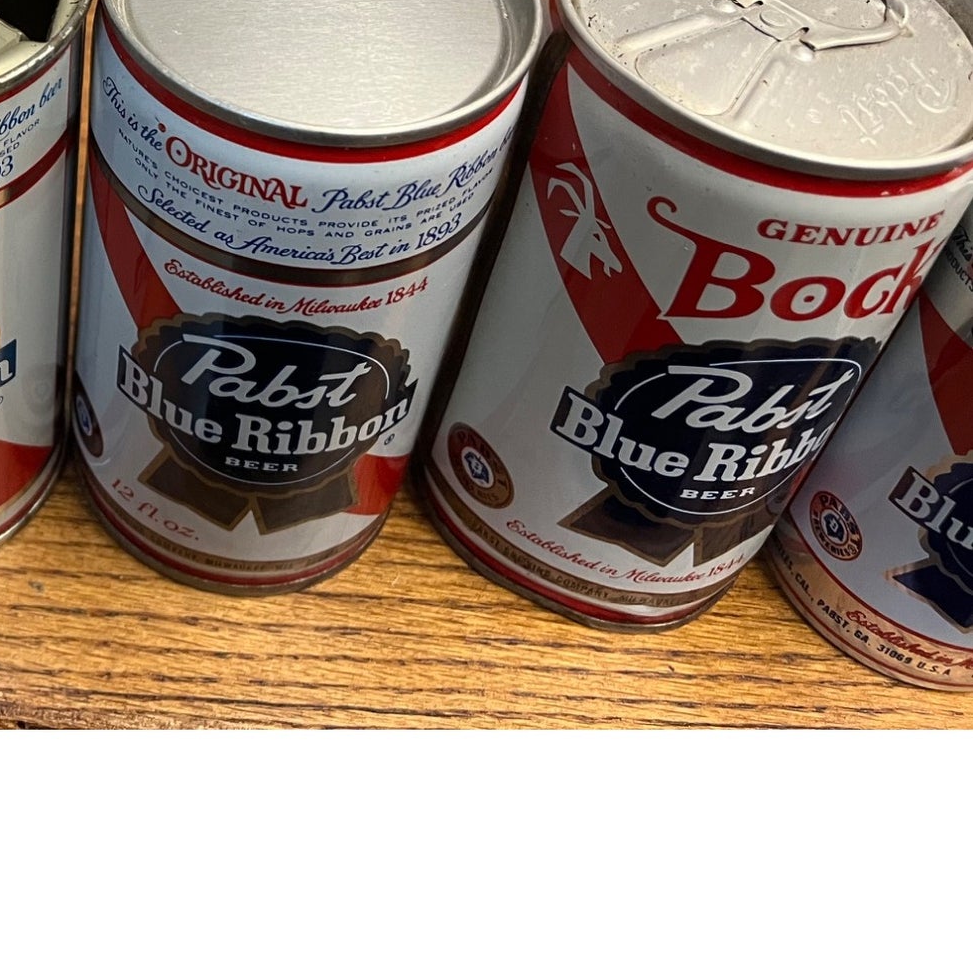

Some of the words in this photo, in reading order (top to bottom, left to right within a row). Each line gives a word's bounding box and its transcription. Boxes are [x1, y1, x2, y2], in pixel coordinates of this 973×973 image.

[38, 77, 63, 110] beer
[3, 118, 41, 148] FLAVOR
[102, 76, 127, 120] This
[127, 114, 139, 131] is
[140, 123, 163, 151] the
[166, 136, 309, 210] ORIGINAL
[311, 188, 385, 213] Pabst
[382, 178, 441, 211] Blue
[436, 148, 499, 198] Ribbon
[118, 127, 158, 170] NATURE'S
[164, 170, 224, 205] CHOICEST
[233, 205, 308, 226] PRODUCTS
[318, 219, 379, 229] PROVIDE
[388, 214, 407, 224] ITS
[416, 196, 456, 218] PRIZED
[134, 157, 159, 179] ONLY
[165, 181, 187, 200] THE
[195, 198, 240, 221] FINEST
[248, 219, 267, 228] OF
[277, 226, 315, 237] HOPS
[325, 230, 354, 238] AND
[364, 222, 412, 238] GRAINS
[421, 211, 443, 224] ARE
[449, 192, 474, 213] USED
[137, 184, 207, 234] Selected
[214, 230, 234, 246] as
[227, 236, 335, 263] America's
[330, 244, 385, 265] Best
[388, 238, 411, 256] in
[417, 212, 462, 249] 1893
[756, 210, 946, 247] GENUINE
[164, 258, 264, 308] Established
[264, 297, 285, 312] in
[282, 296, 383, 316] Milwaukee
[386, 276, 428, 306] 1844
[646, 195, 946, 321] Bock
[180, 333, 372, 409] Pabst
[651, 365, 855, 434] Pabst
[119, 350, 223, 445] Blue
[231, 397, 409, 457] Ribbon
[555, 392, 690, 478] Blue
[111, 479, 136, 502] 12
[225, 456, 299, 472] BEER
[679, 486, 756, 500] BEER
[506, 519, 599, 570] Established
[598, 562, 617, 577] in
[615, 568, 705, 583] Milwaukee
[709, 552, 746, 577] 1844
[846, 610, 940, 659] Established
[876, 643, 914, 665] 31069
